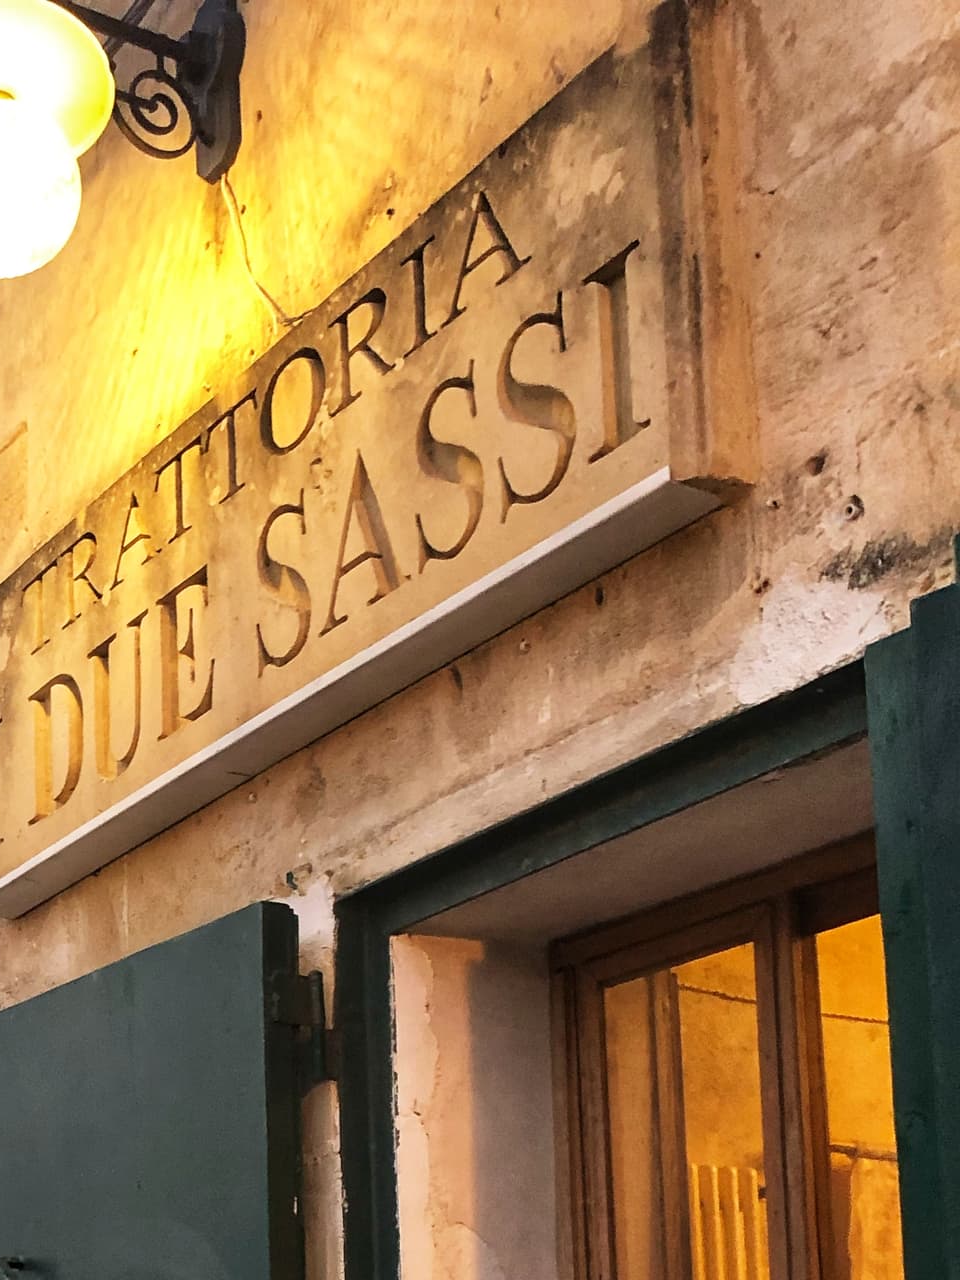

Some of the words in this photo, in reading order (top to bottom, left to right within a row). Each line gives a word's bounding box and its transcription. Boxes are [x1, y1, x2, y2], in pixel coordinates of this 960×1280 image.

[21, 189, 532, 655] TRATTORIA
[27, 564, 216, 827] DUE
[255, 238, 652, 680] SASSI
